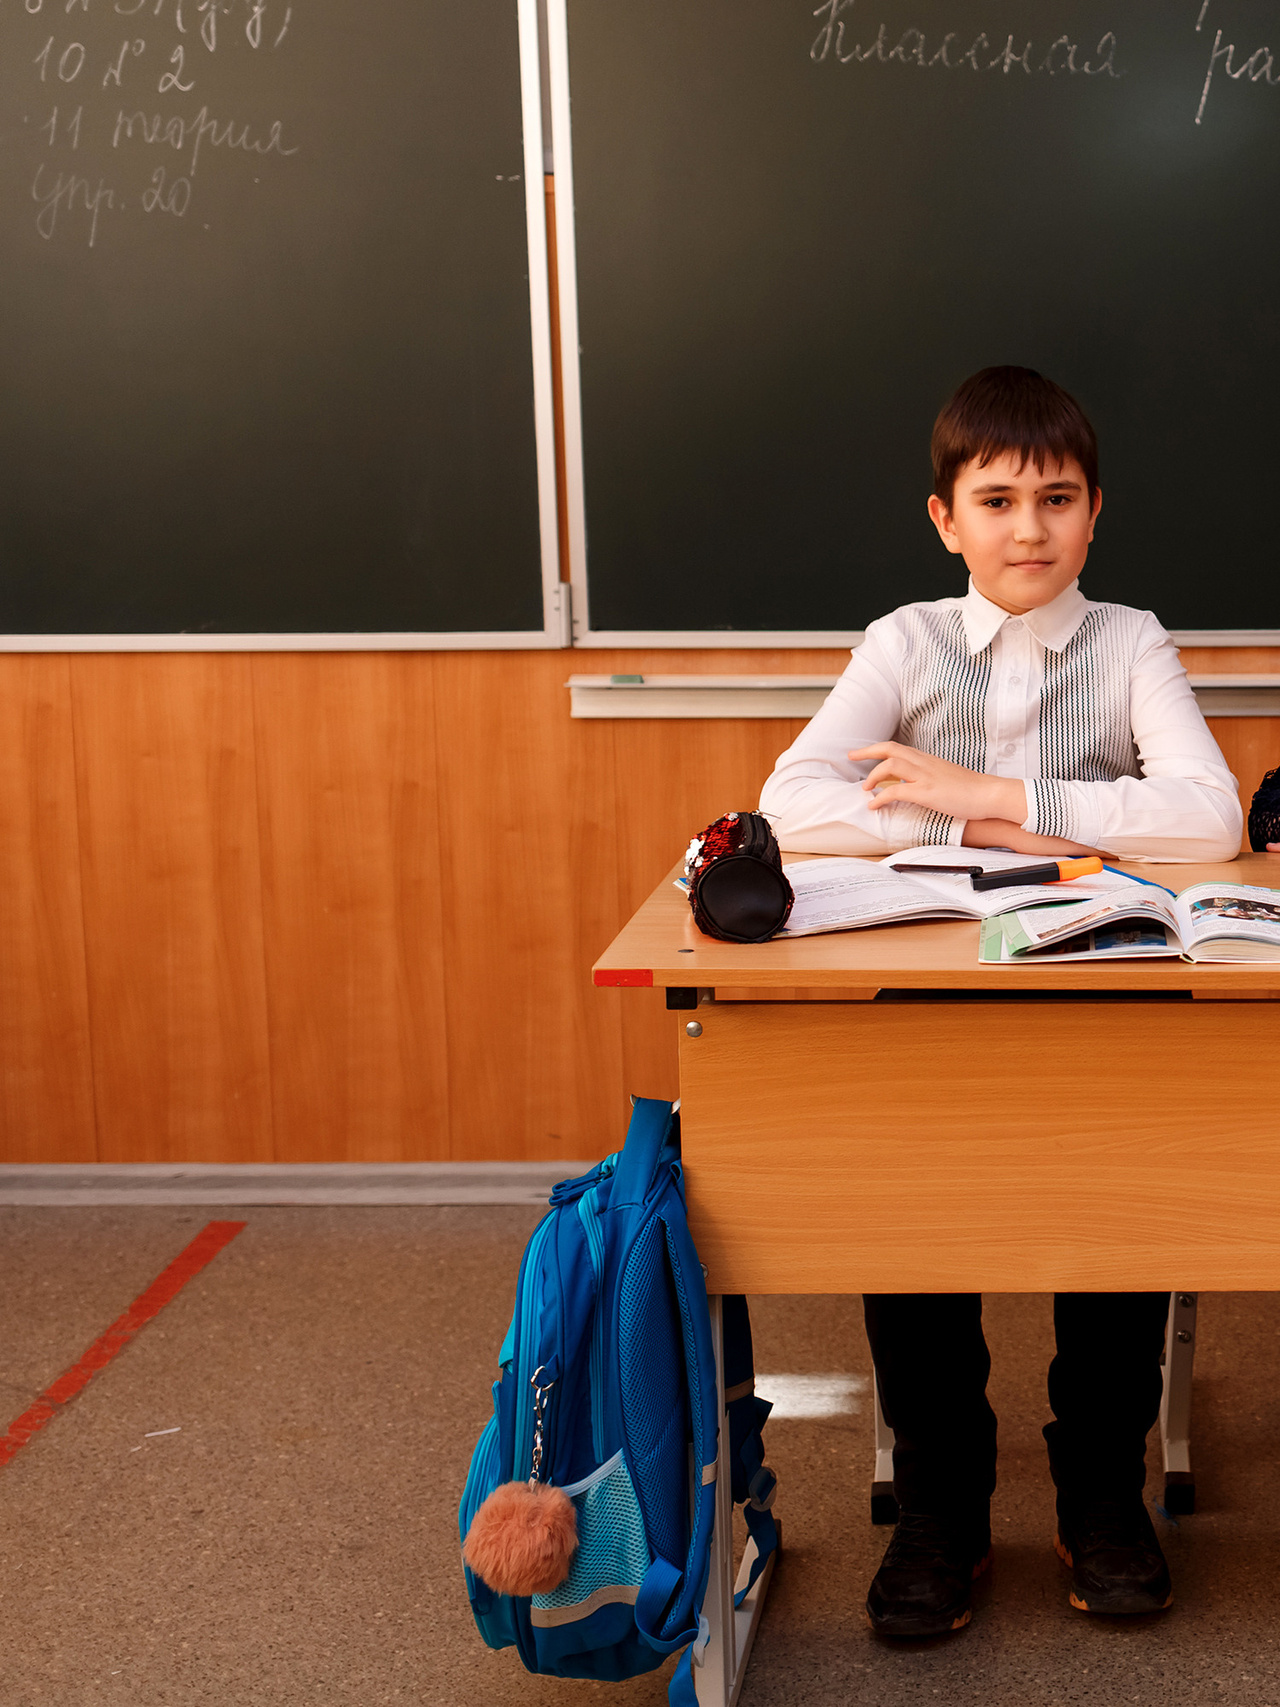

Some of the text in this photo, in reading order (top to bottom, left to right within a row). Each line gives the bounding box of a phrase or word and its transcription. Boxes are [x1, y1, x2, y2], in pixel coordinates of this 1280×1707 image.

[34, 36, 86, 83] 10
[158, 44, 195, 93] 2
[42, 105, 300, 177] 11 теория
[142, 165, 192, 218] 20
